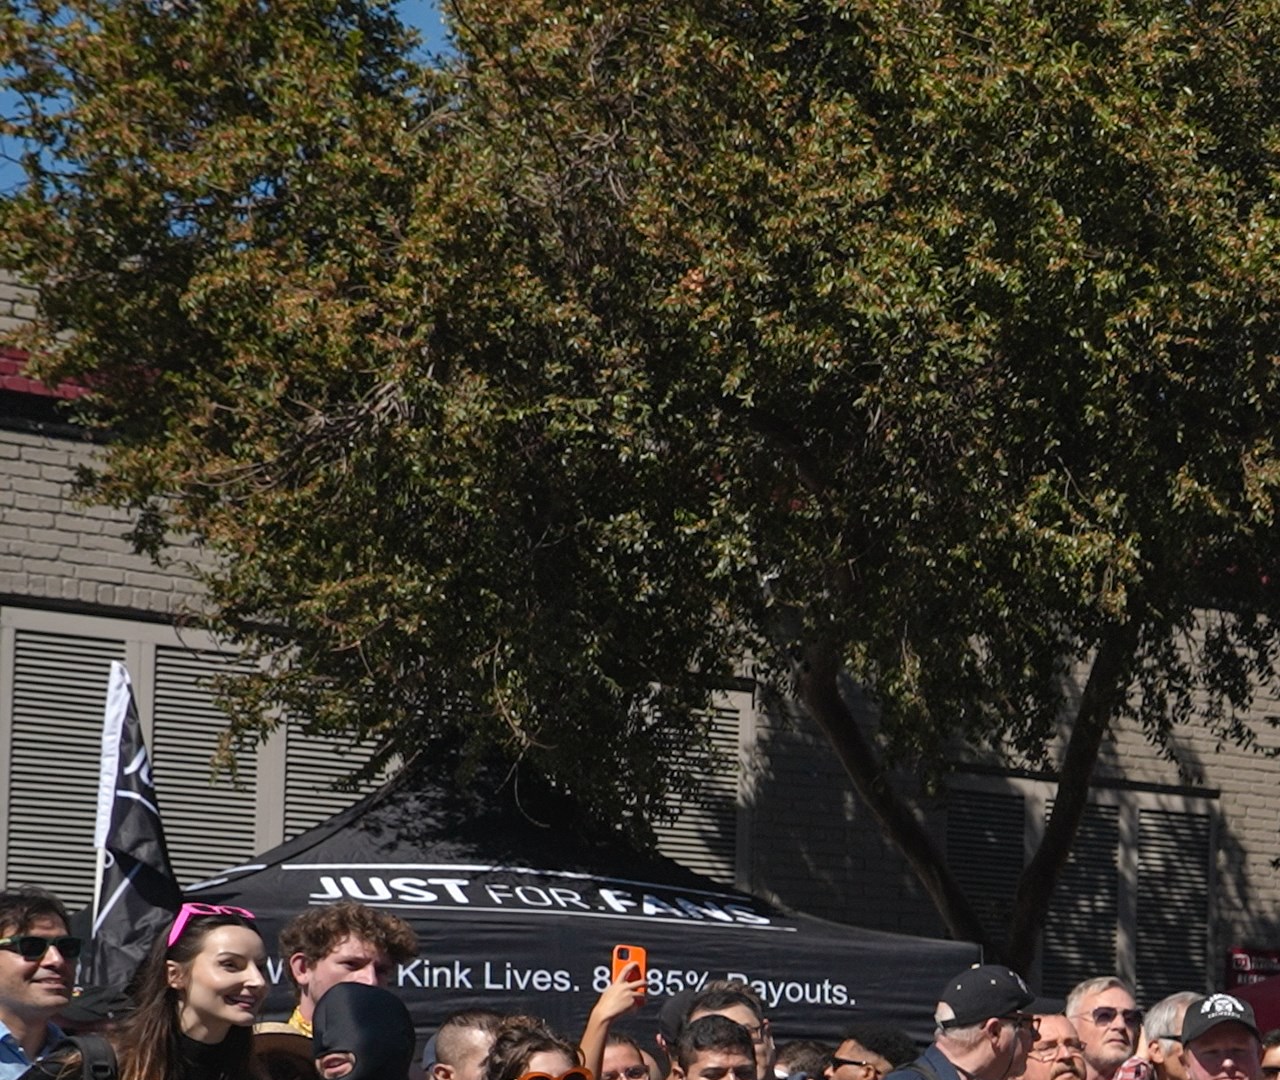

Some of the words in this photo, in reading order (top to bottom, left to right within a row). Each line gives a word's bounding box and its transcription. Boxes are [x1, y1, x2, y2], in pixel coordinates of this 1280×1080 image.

[309, 876, 470, 904] JUST
[397, 959, 473, 990] Kink
[484, 961, 580, 993] Lives.
